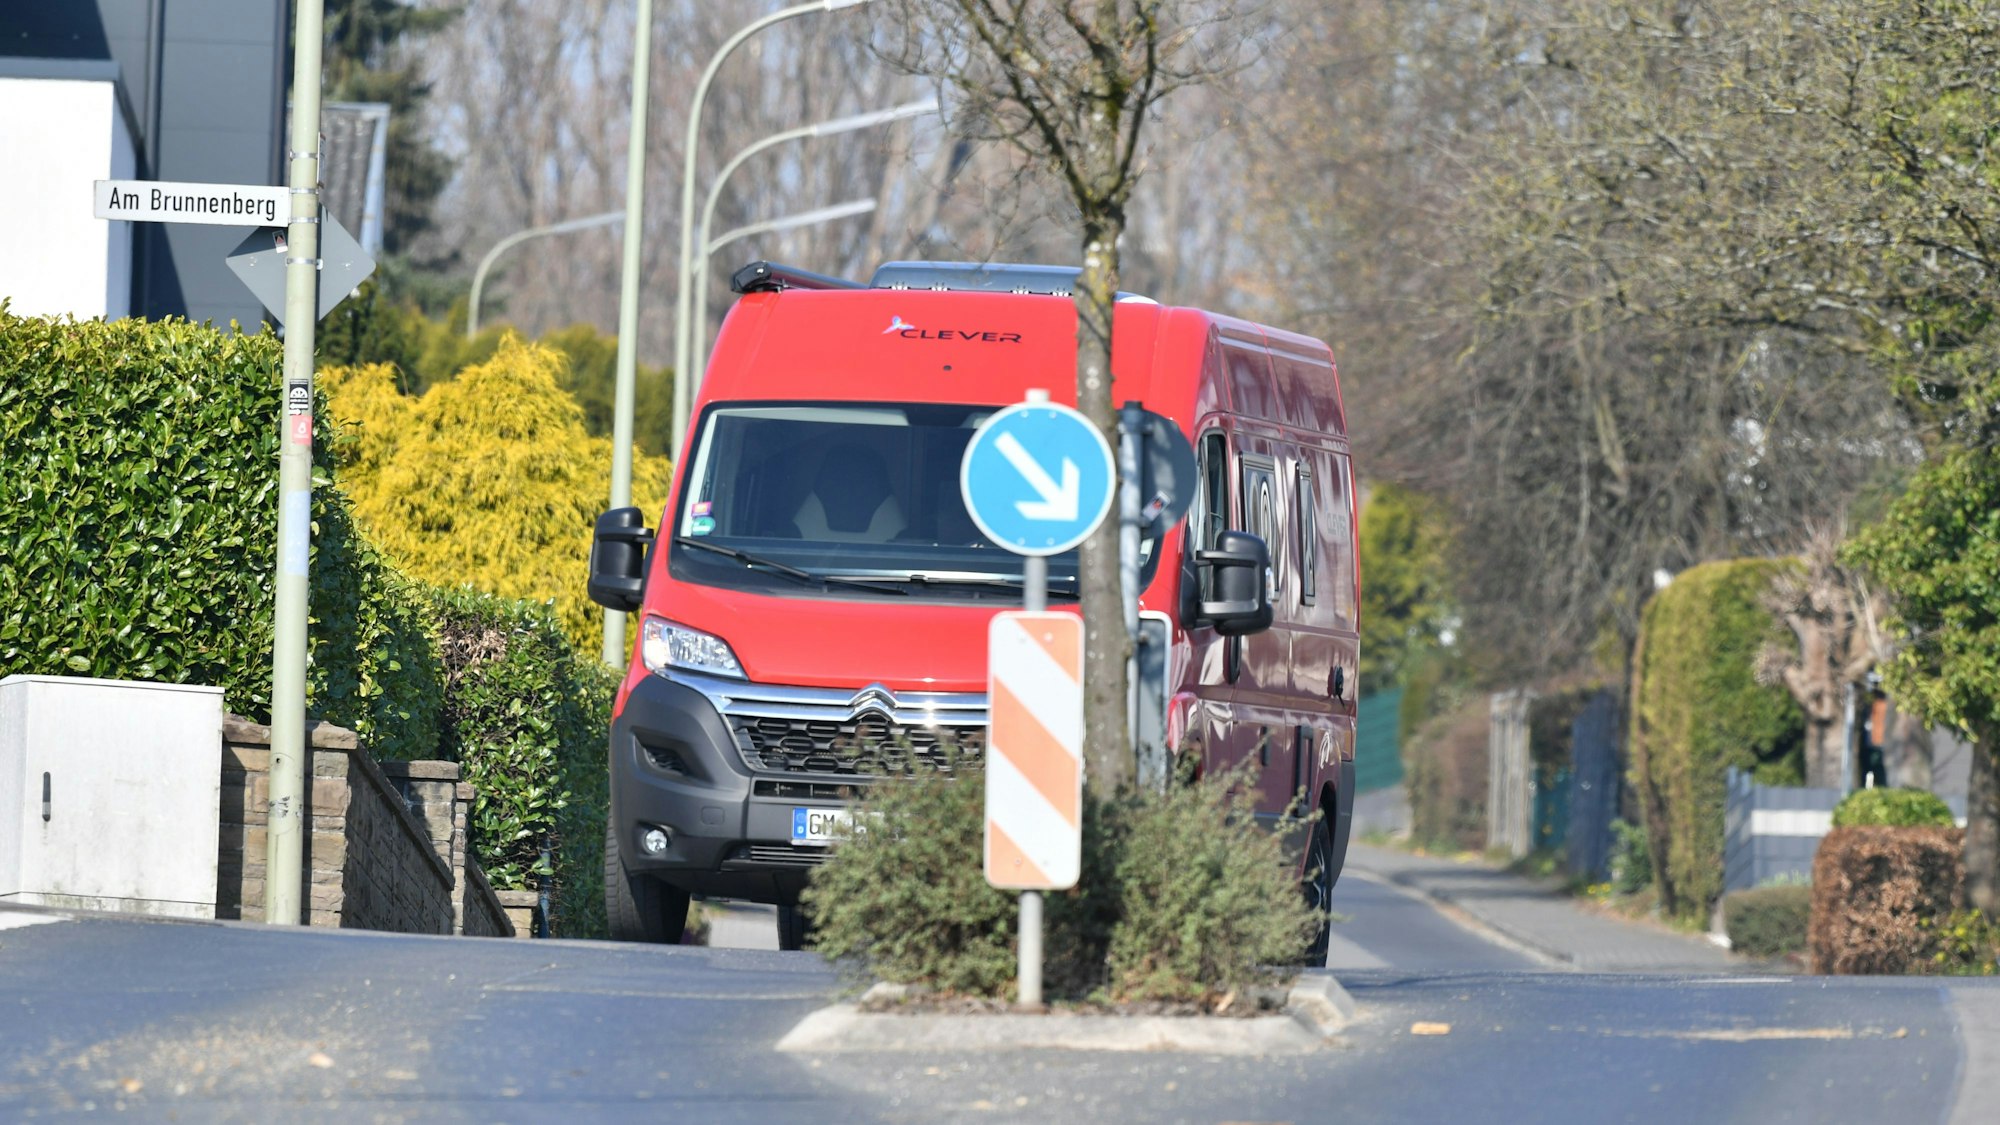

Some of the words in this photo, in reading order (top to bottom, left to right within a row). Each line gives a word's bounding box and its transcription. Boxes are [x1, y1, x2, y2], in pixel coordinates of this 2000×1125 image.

[109, 187, 139, 210] Am
[151, 188, 276, 222] Brunnenberg
[900, 329, 1022, 343] CLEVER
